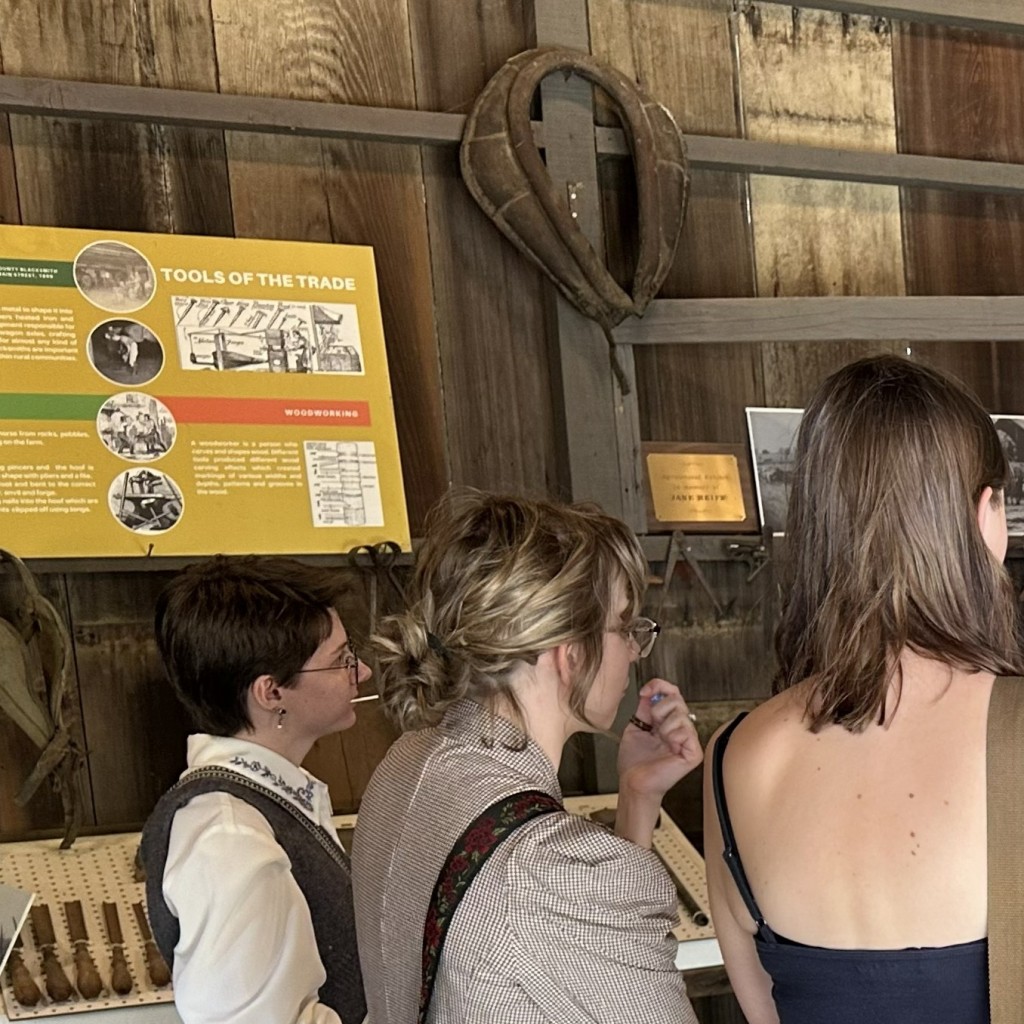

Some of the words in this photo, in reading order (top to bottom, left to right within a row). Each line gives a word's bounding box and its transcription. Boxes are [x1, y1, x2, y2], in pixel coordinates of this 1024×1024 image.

[160, 268, 226, 284] TOOLS
[228, 272, 254, 286] OF
[256, 273, 294, 288] THE
[296, 275, 356, 290] TRADE
[284, 408, 359, 418] WOODWORKING
